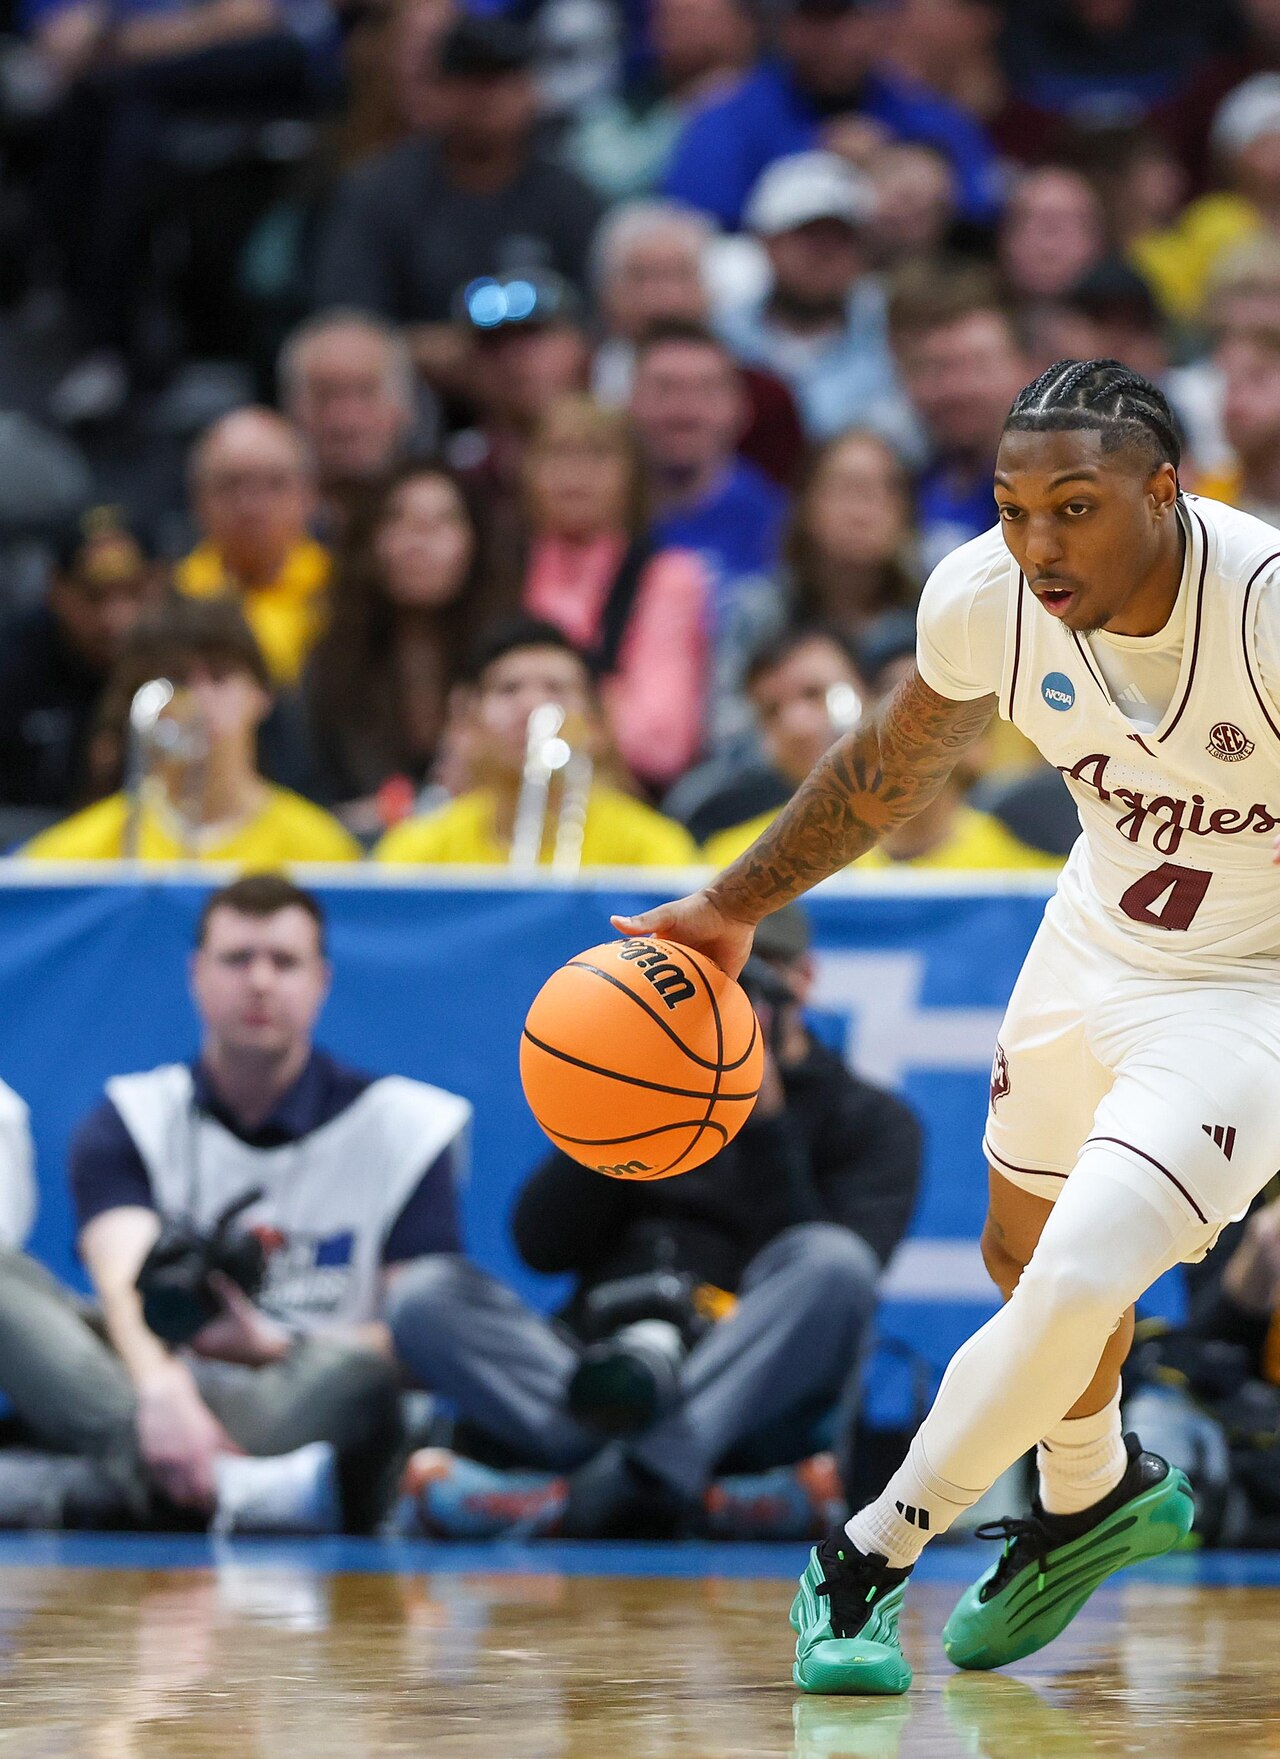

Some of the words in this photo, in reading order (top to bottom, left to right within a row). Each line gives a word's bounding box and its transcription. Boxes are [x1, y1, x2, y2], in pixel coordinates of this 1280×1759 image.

[1045, 687, 1072, 706] NCAA
[1212, 725, 1243, 752] SEC
[1213, 747, 1251, 762] GRADUATE
[1119, 862, 1213, 931] 4
[606, 939, 696, 1010] Wils
